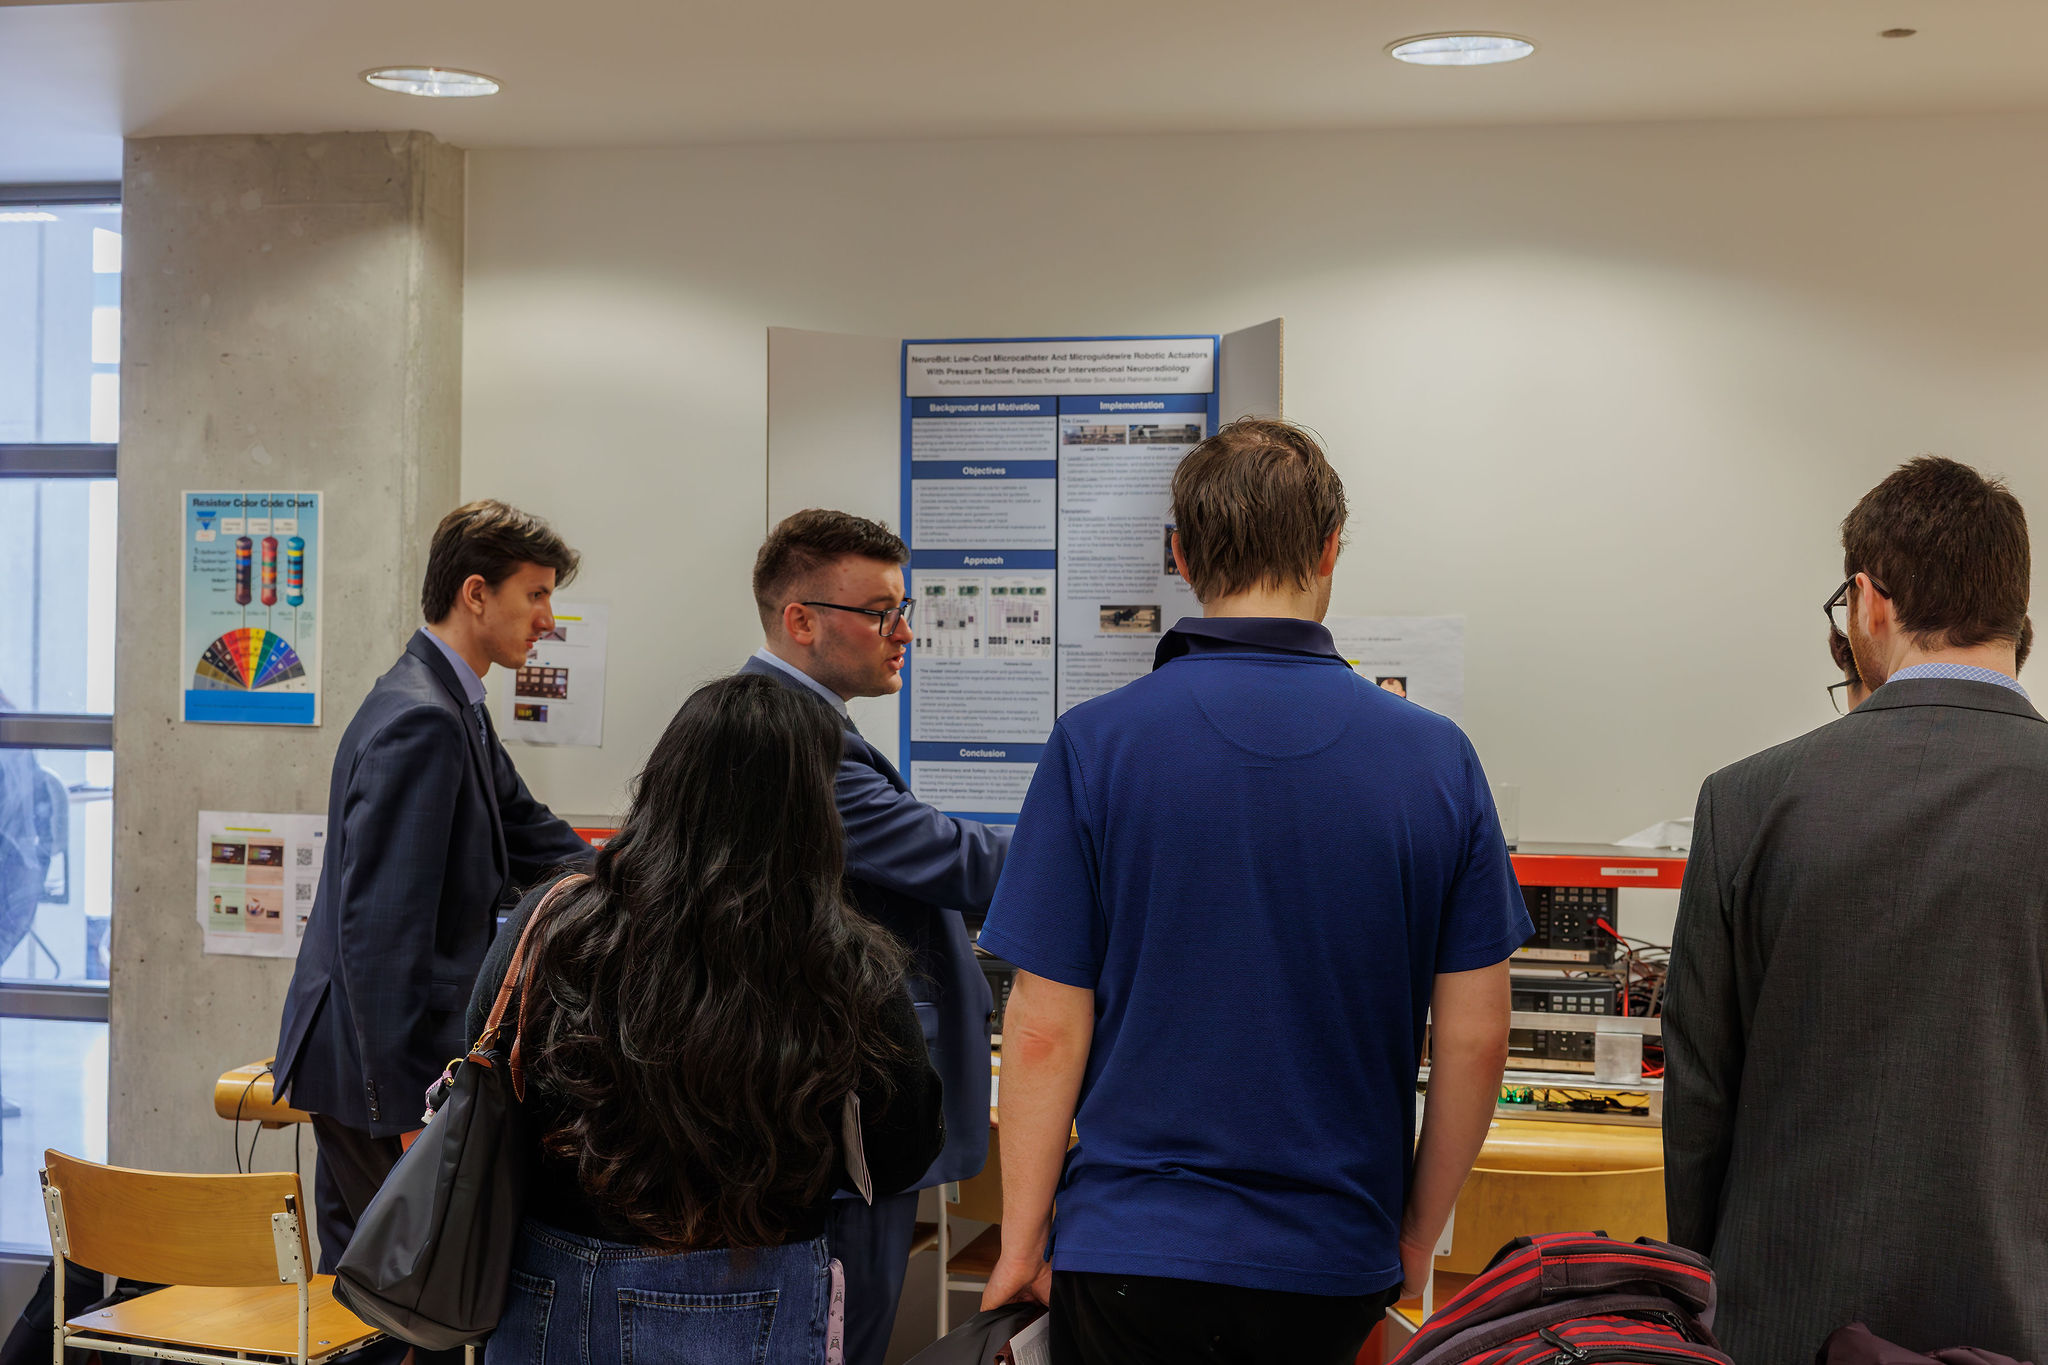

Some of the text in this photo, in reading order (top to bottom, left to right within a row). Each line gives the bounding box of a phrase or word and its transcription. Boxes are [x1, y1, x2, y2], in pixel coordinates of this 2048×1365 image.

[954, 354, 992, 363] Low-Cost
[993, 353, 1048, 362] Microcatheter
[1051, 353, 1067, 361] And
[1069, 352, 1132, 362] Microguidewire
[1134, 351, 1166, 360] Robotic
[1168, 351, 1208, 359] Actuators
[926, 364, 1191, 376] With Pressure Tactile Feedback For Interventional Neuroradiology
[929, 404, 978, 413] Background
[997, 403, 1040, 411] Motivation
[1099, 401, 1165, 411] Implementation
[962, 466, 1006, 477] Objectives
[192, 498, 314, 508] Resistor Color Code Chart
[963, 556, 1004, 566] Approach
[960, 748, 1006, 757] Conclusion
